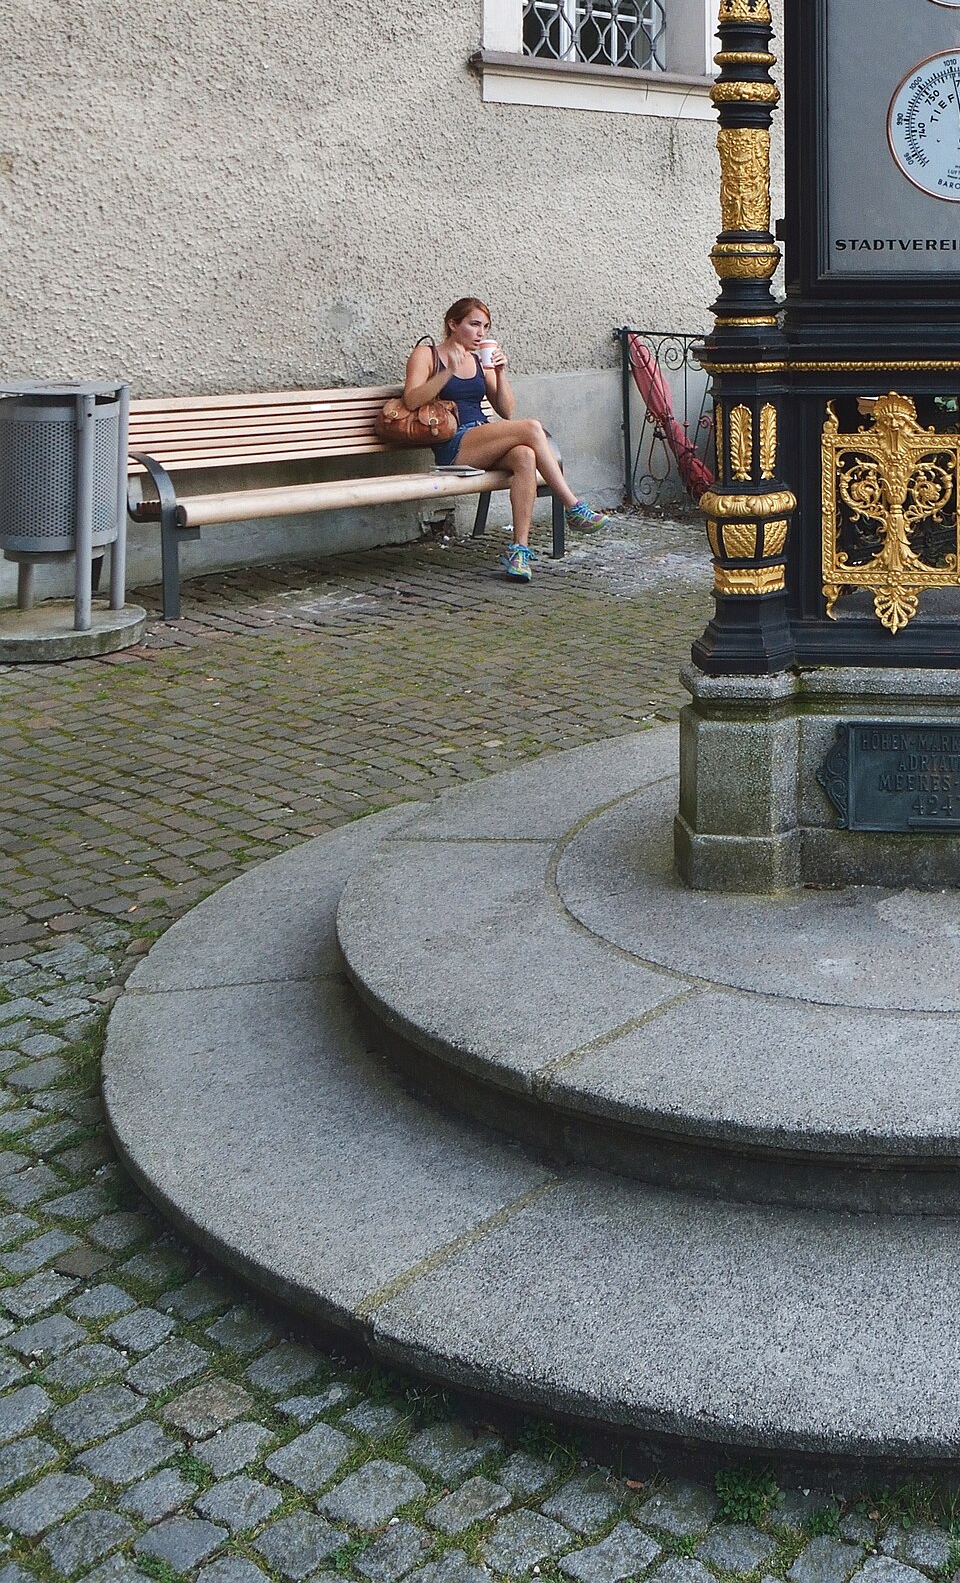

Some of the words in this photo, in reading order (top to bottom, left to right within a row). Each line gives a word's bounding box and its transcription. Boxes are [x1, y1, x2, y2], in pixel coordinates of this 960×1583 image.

[943, 59, 957, 67] 1010
[909, 77, 922, 90] 1000
[925, 90, 940, 105] 750
[930, 94, 954, 123] TIEF
[918, 123, 926, 139] 740
[904, 153, 914, 165] 980
